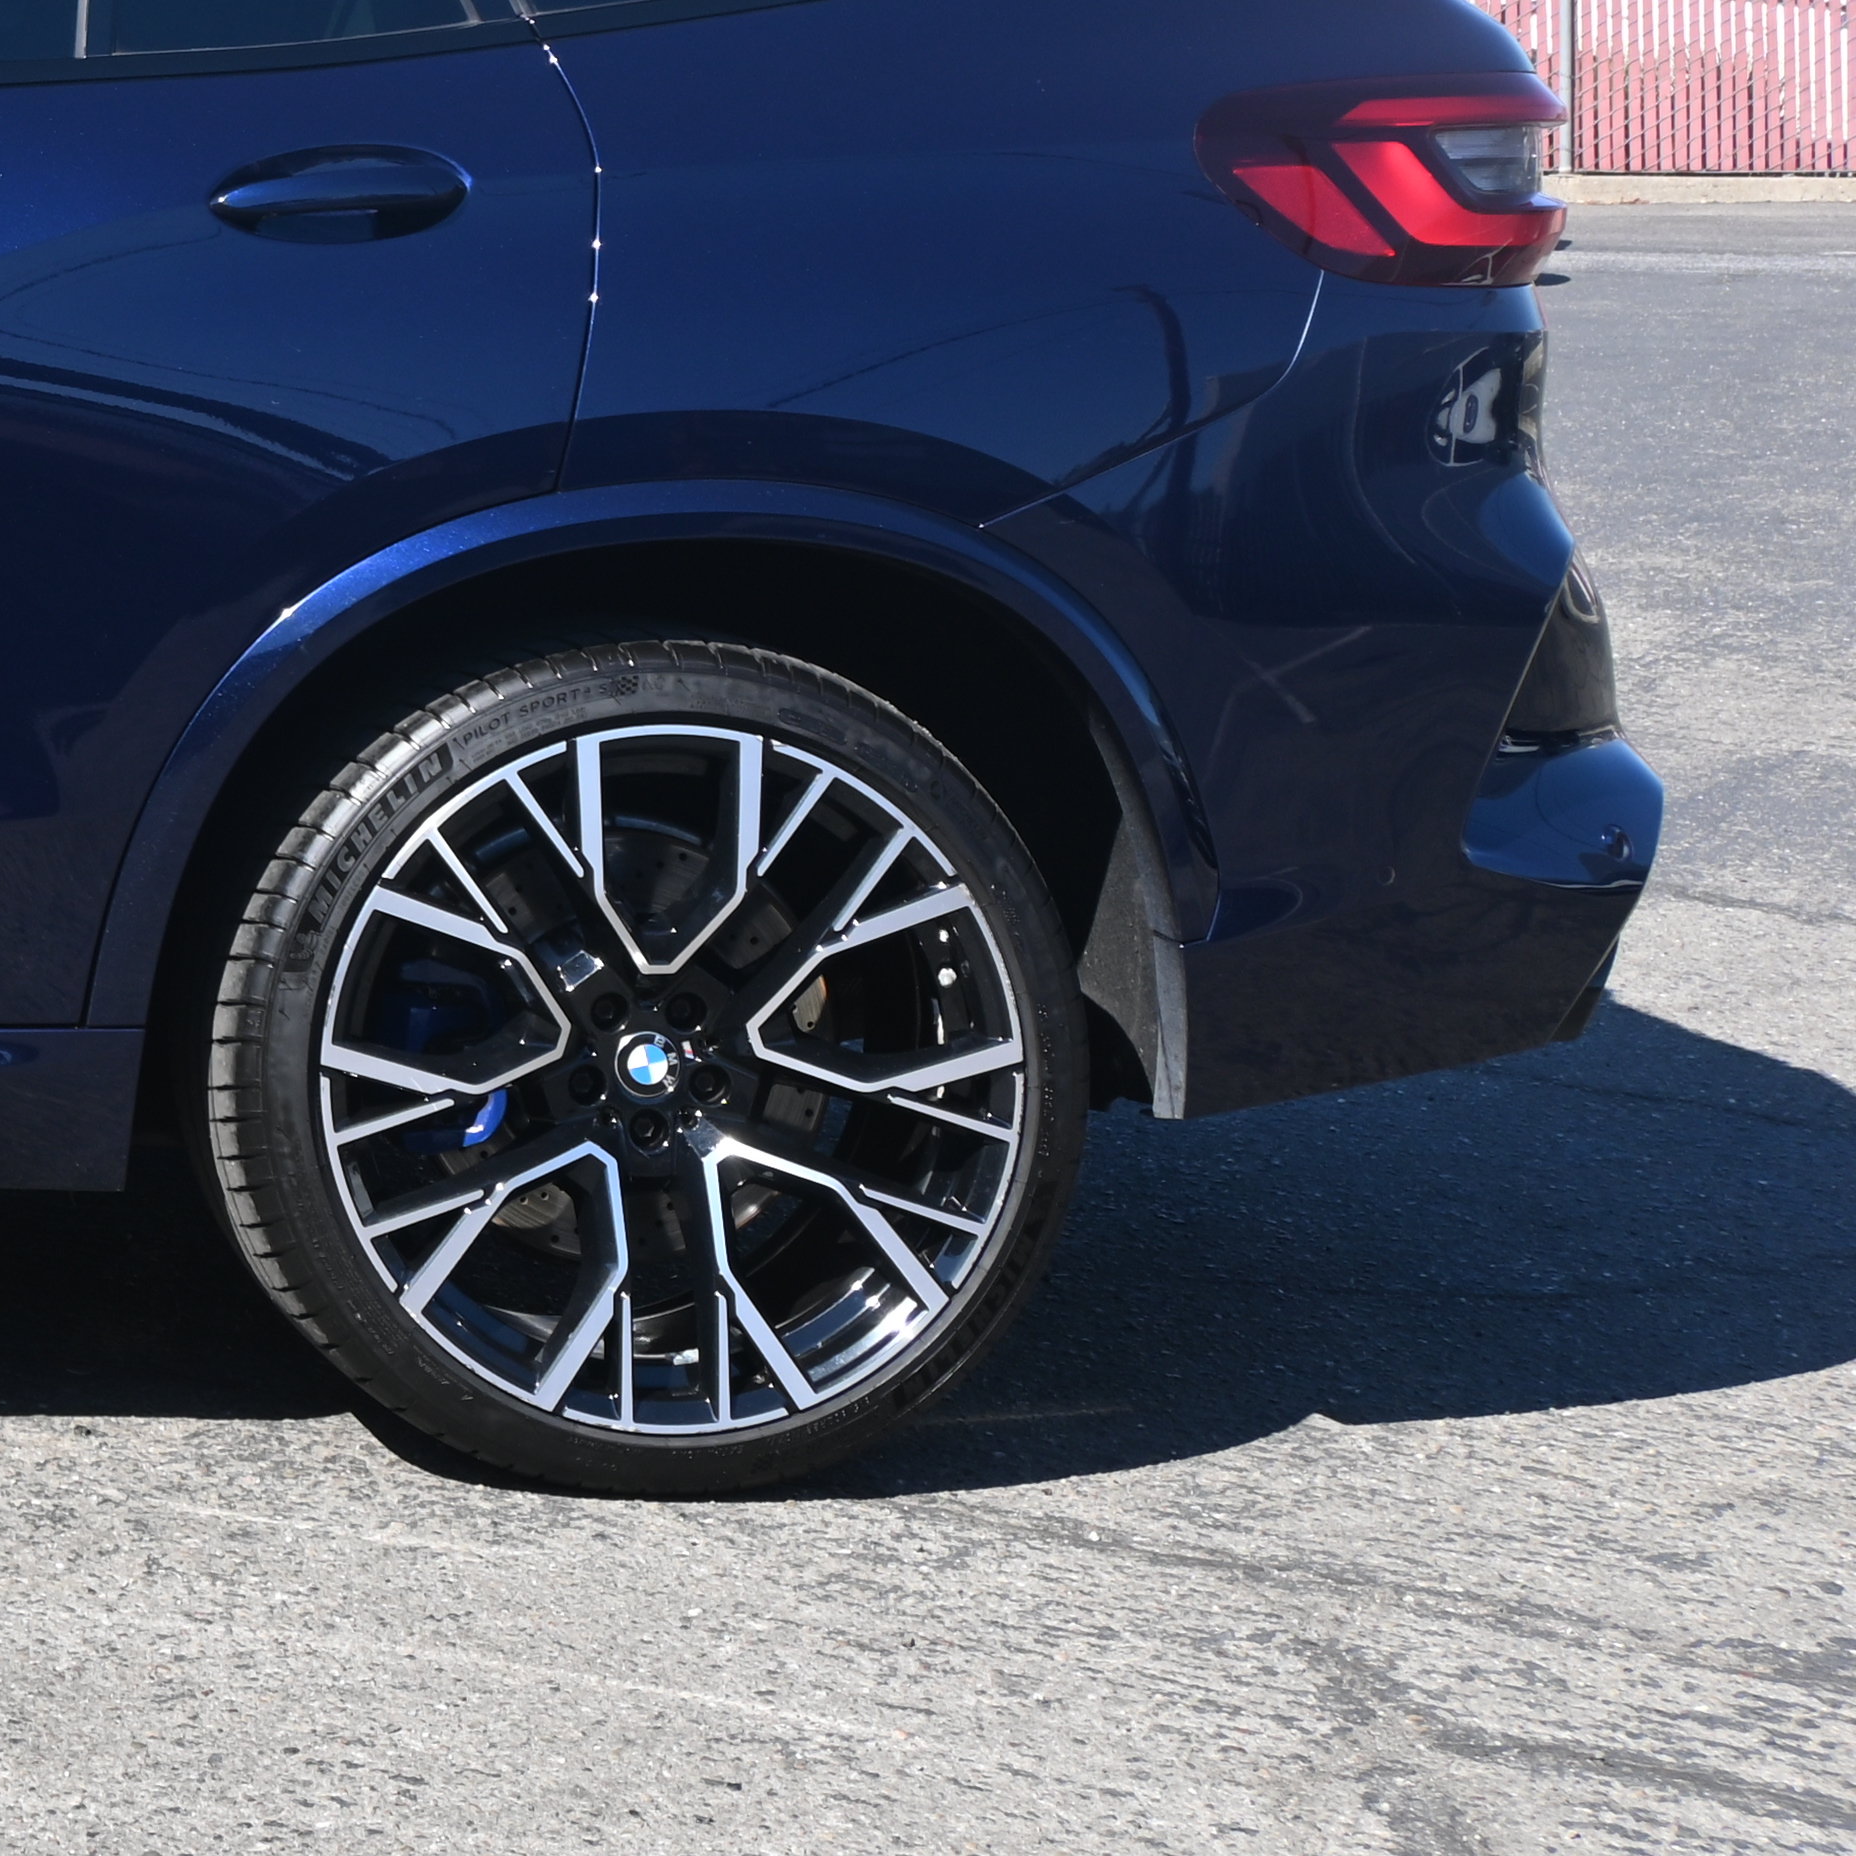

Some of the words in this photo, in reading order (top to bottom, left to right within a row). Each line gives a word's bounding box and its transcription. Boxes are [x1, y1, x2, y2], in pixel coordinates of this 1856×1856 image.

[460, 709, 514, 747] PILOT
[515, 685, 583, 721] SPORT
[303, 750, 448, 924] MICHELIN
